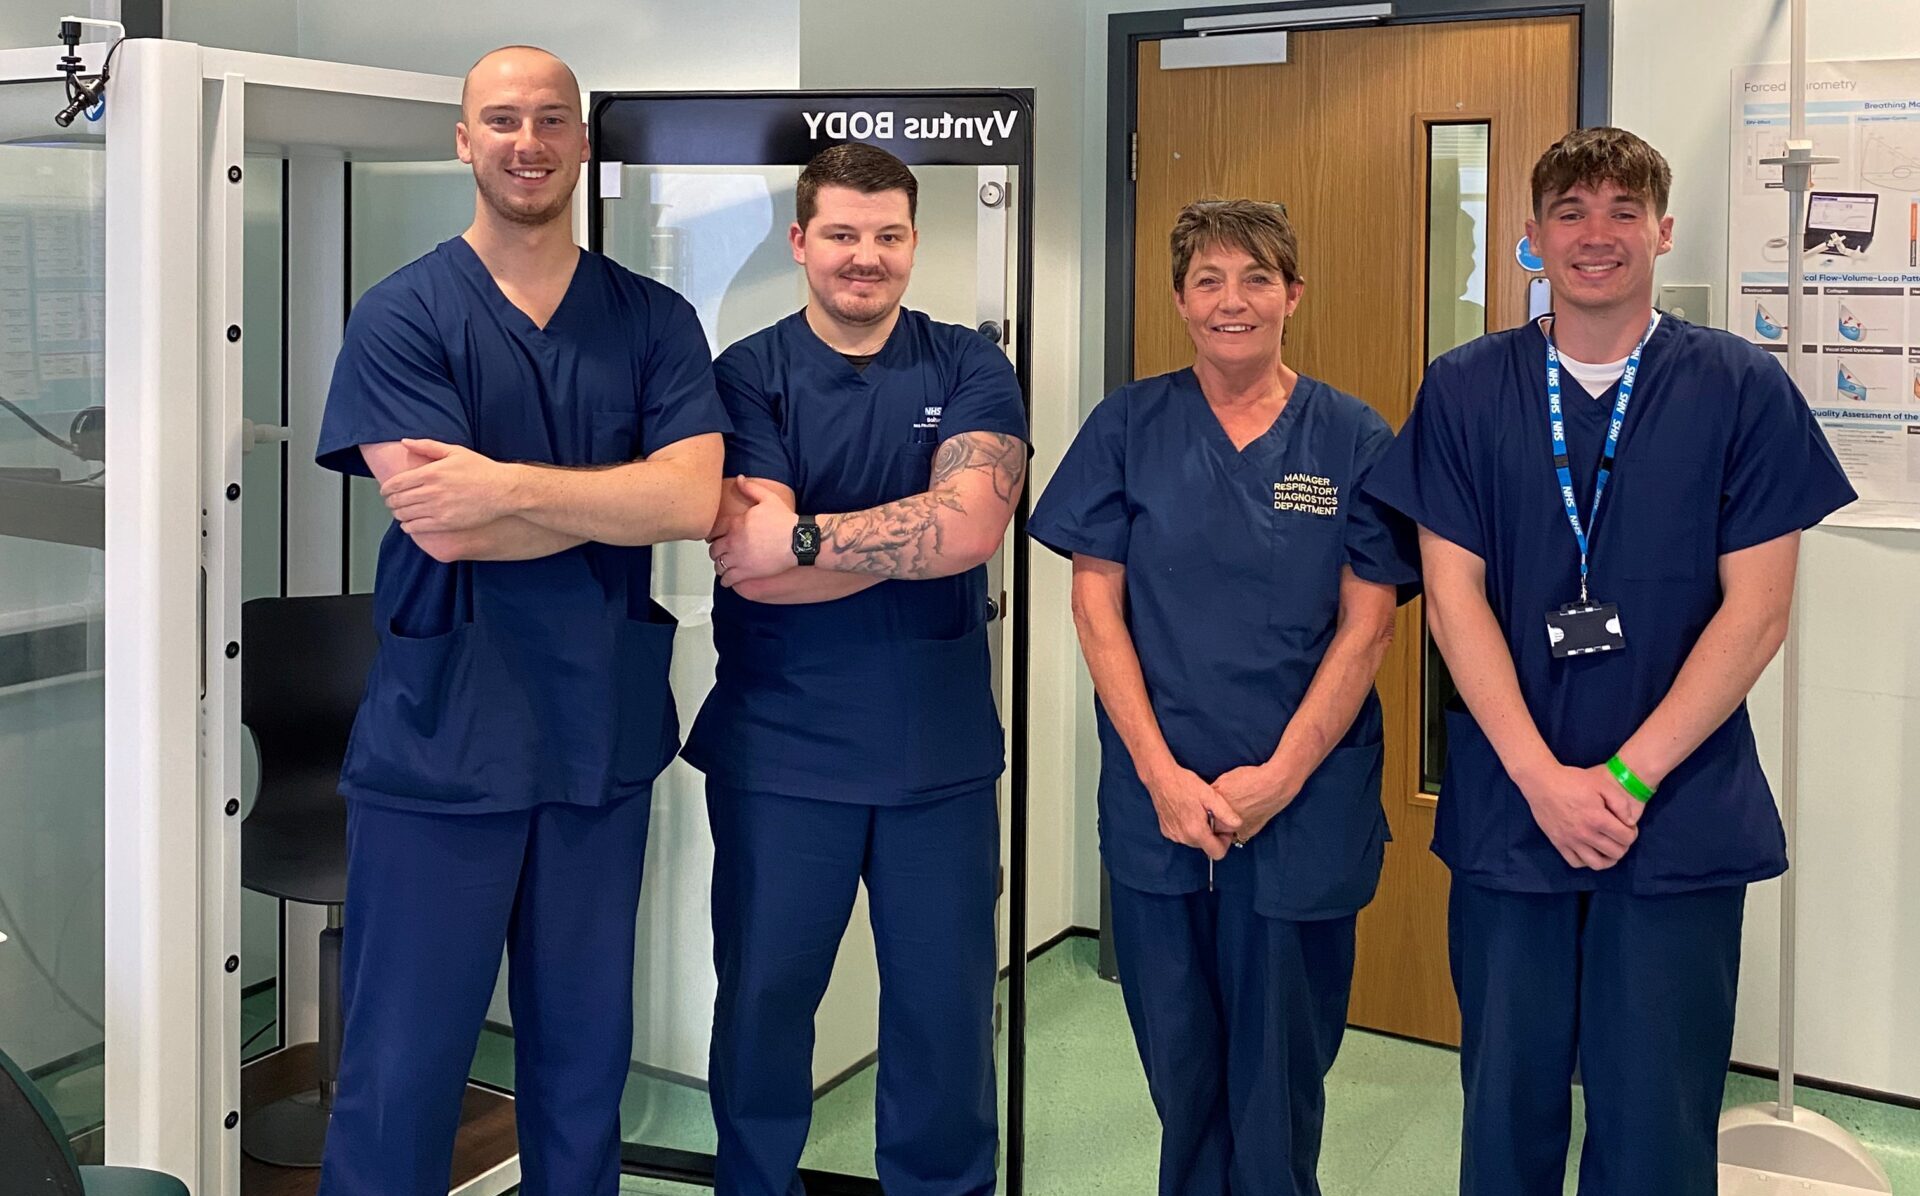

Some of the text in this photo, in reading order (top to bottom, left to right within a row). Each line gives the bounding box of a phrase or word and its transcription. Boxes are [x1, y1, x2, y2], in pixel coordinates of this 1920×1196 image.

[1744, 80, 1858, 93] Forced irometry
[1864, 102, 1907, 110] Breathing
[1819, 274, 1899, 284] Flow-Volume-Loop
[1901, 274, 1920, 283] Patt
[1548, 368, 1559, 387] NHS
[1550, 394, 1561, 414] NHS
[1609, 418, 1622, 441] NHS
[1616, 392, 1629, 414] NHS
[1623, 365, 1636, 387] NHS
[925, 407, 942, 415] NHS
[1810, 409, 1919, 421] Quality Assessment of the
[1552, 421, 1564, 441] NHS
[1284, 473, 1330, 486] MANAGER
[1273, 482, 1339, 495] RESPIRATORY
[1274, 492, 1338, 505] DIAGNOSTICS
[1274, 501, 1338, 515] DEPARTMENT
[1563, 486, 1583, 535] NHS NHS
